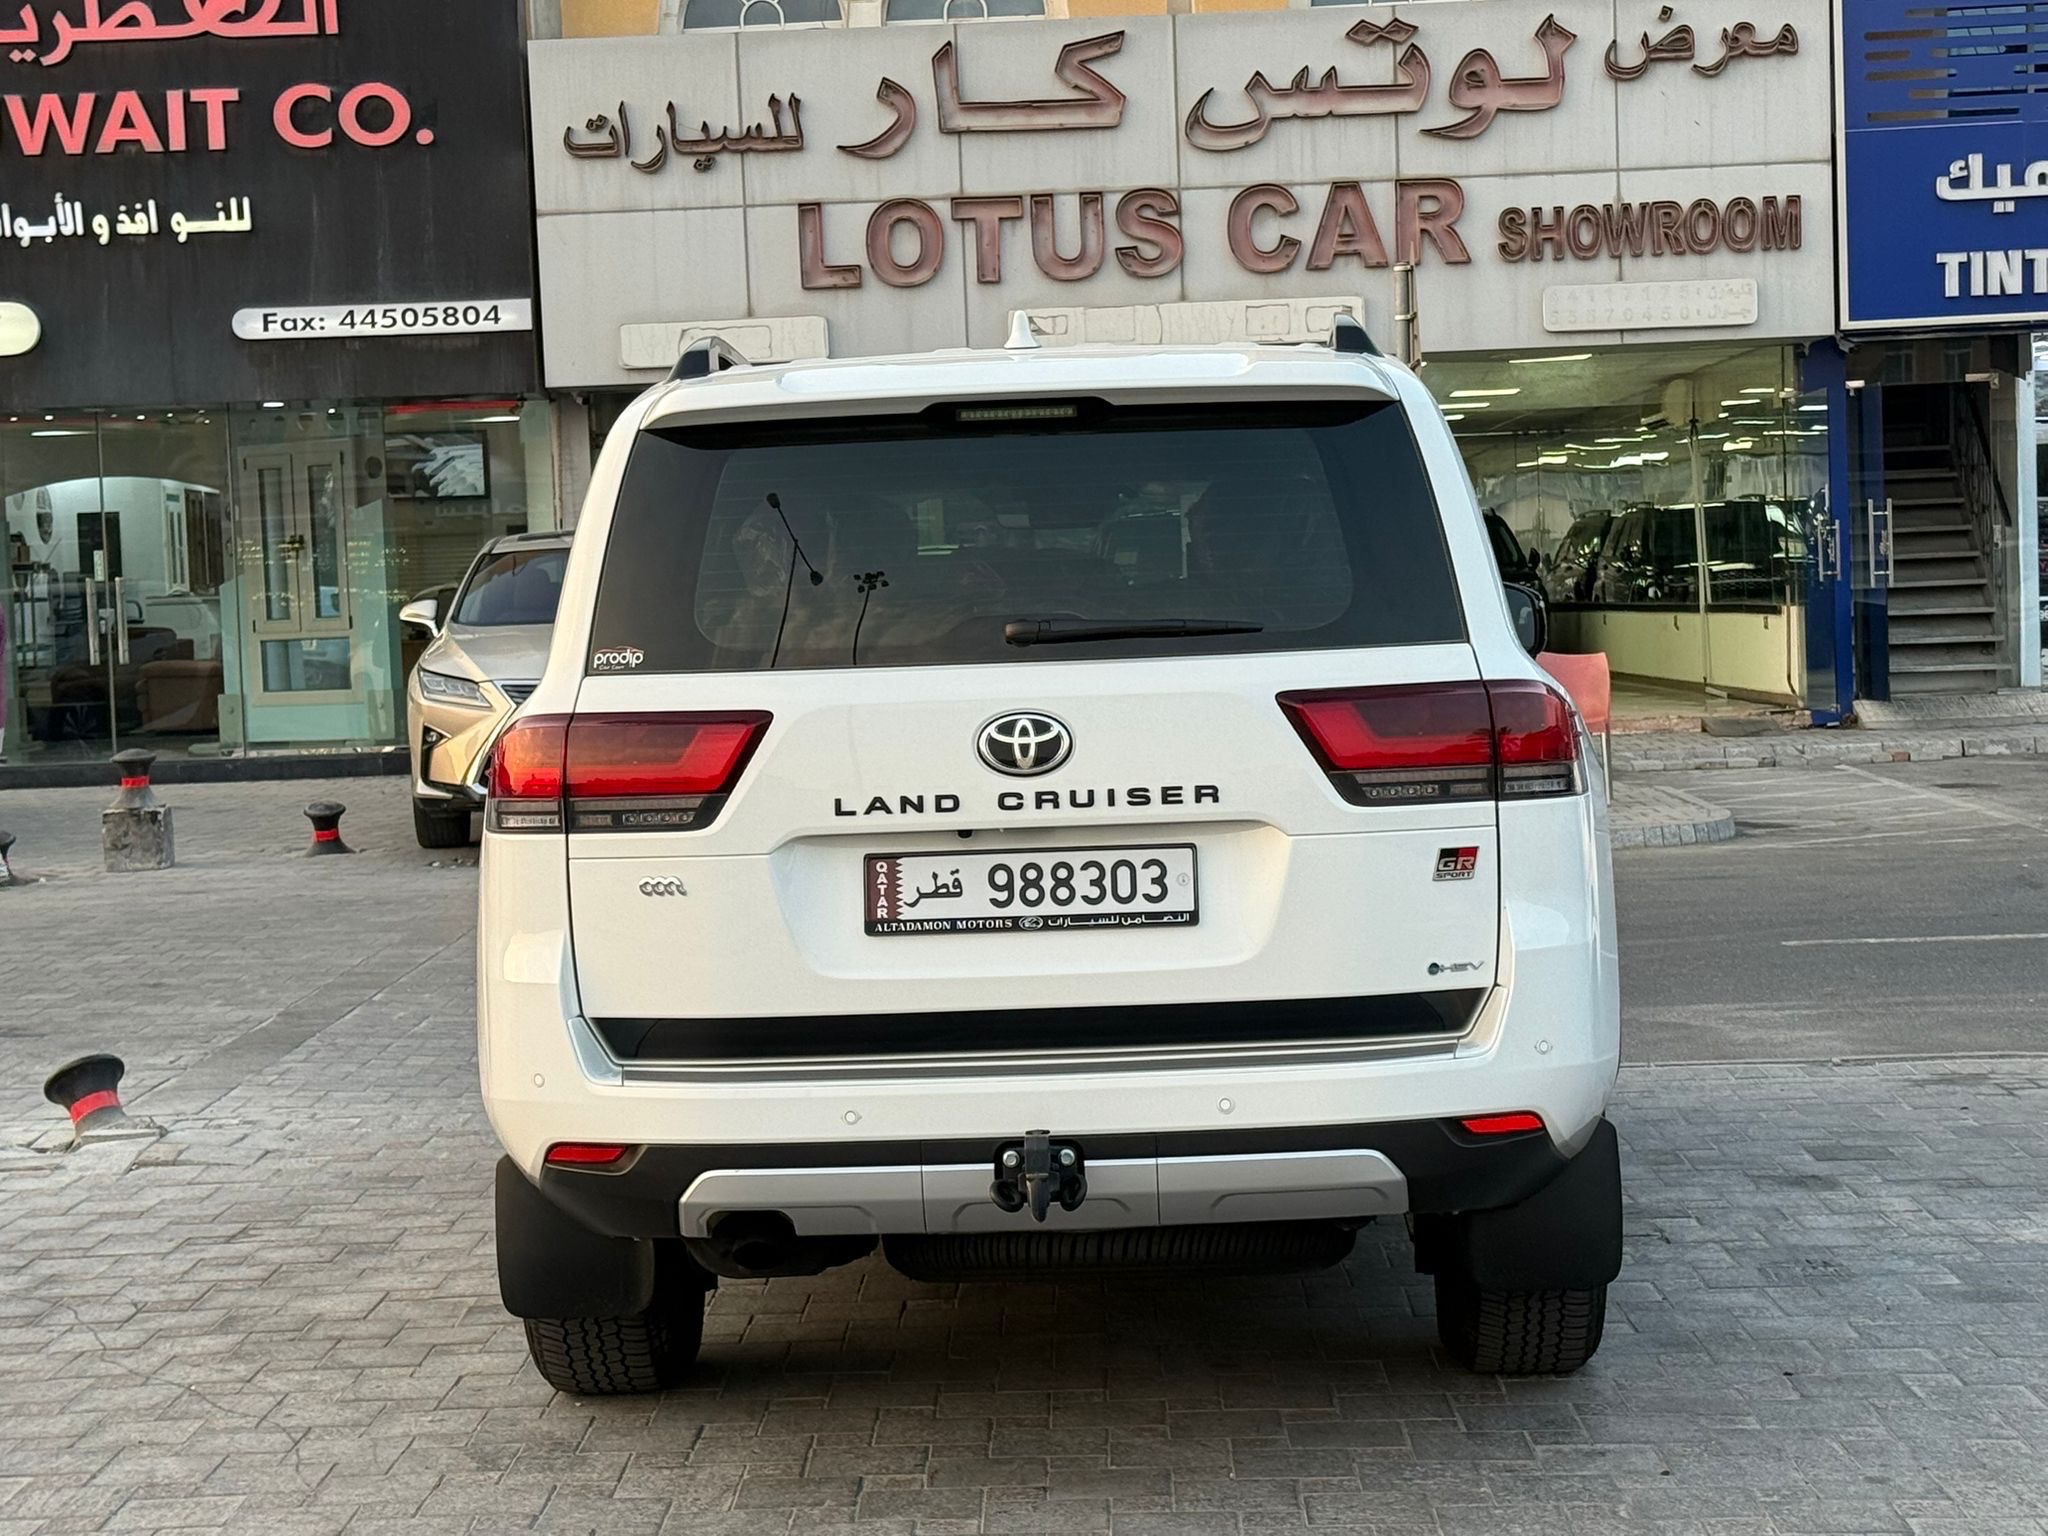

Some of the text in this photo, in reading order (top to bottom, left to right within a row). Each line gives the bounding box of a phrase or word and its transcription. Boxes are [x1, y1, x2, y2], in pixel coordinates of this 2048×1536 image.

[563, 5, 1799, 175] معرض لوتس كار للسيارات
[272, 82, 436, 148] CO.
[0, 191, 85, 248] الأبوا
[798, 176, 1803, 290] LOTUS CAR SHOWROOM
[261, 305, 502, 333] Fax: 44505804
[834, 784, 1220, 817] LAND CRUISER
[987, 858, 1168, 909] 988303
[1435, 871, 1473, 879] SPORT
[1438, 857, 1475, 871] GR
[875, 861, 888, 919] QATAR
[903, 868, 963, 908] قطر
[875, 918, 1013, 932] ALTADAMON MOTORS
